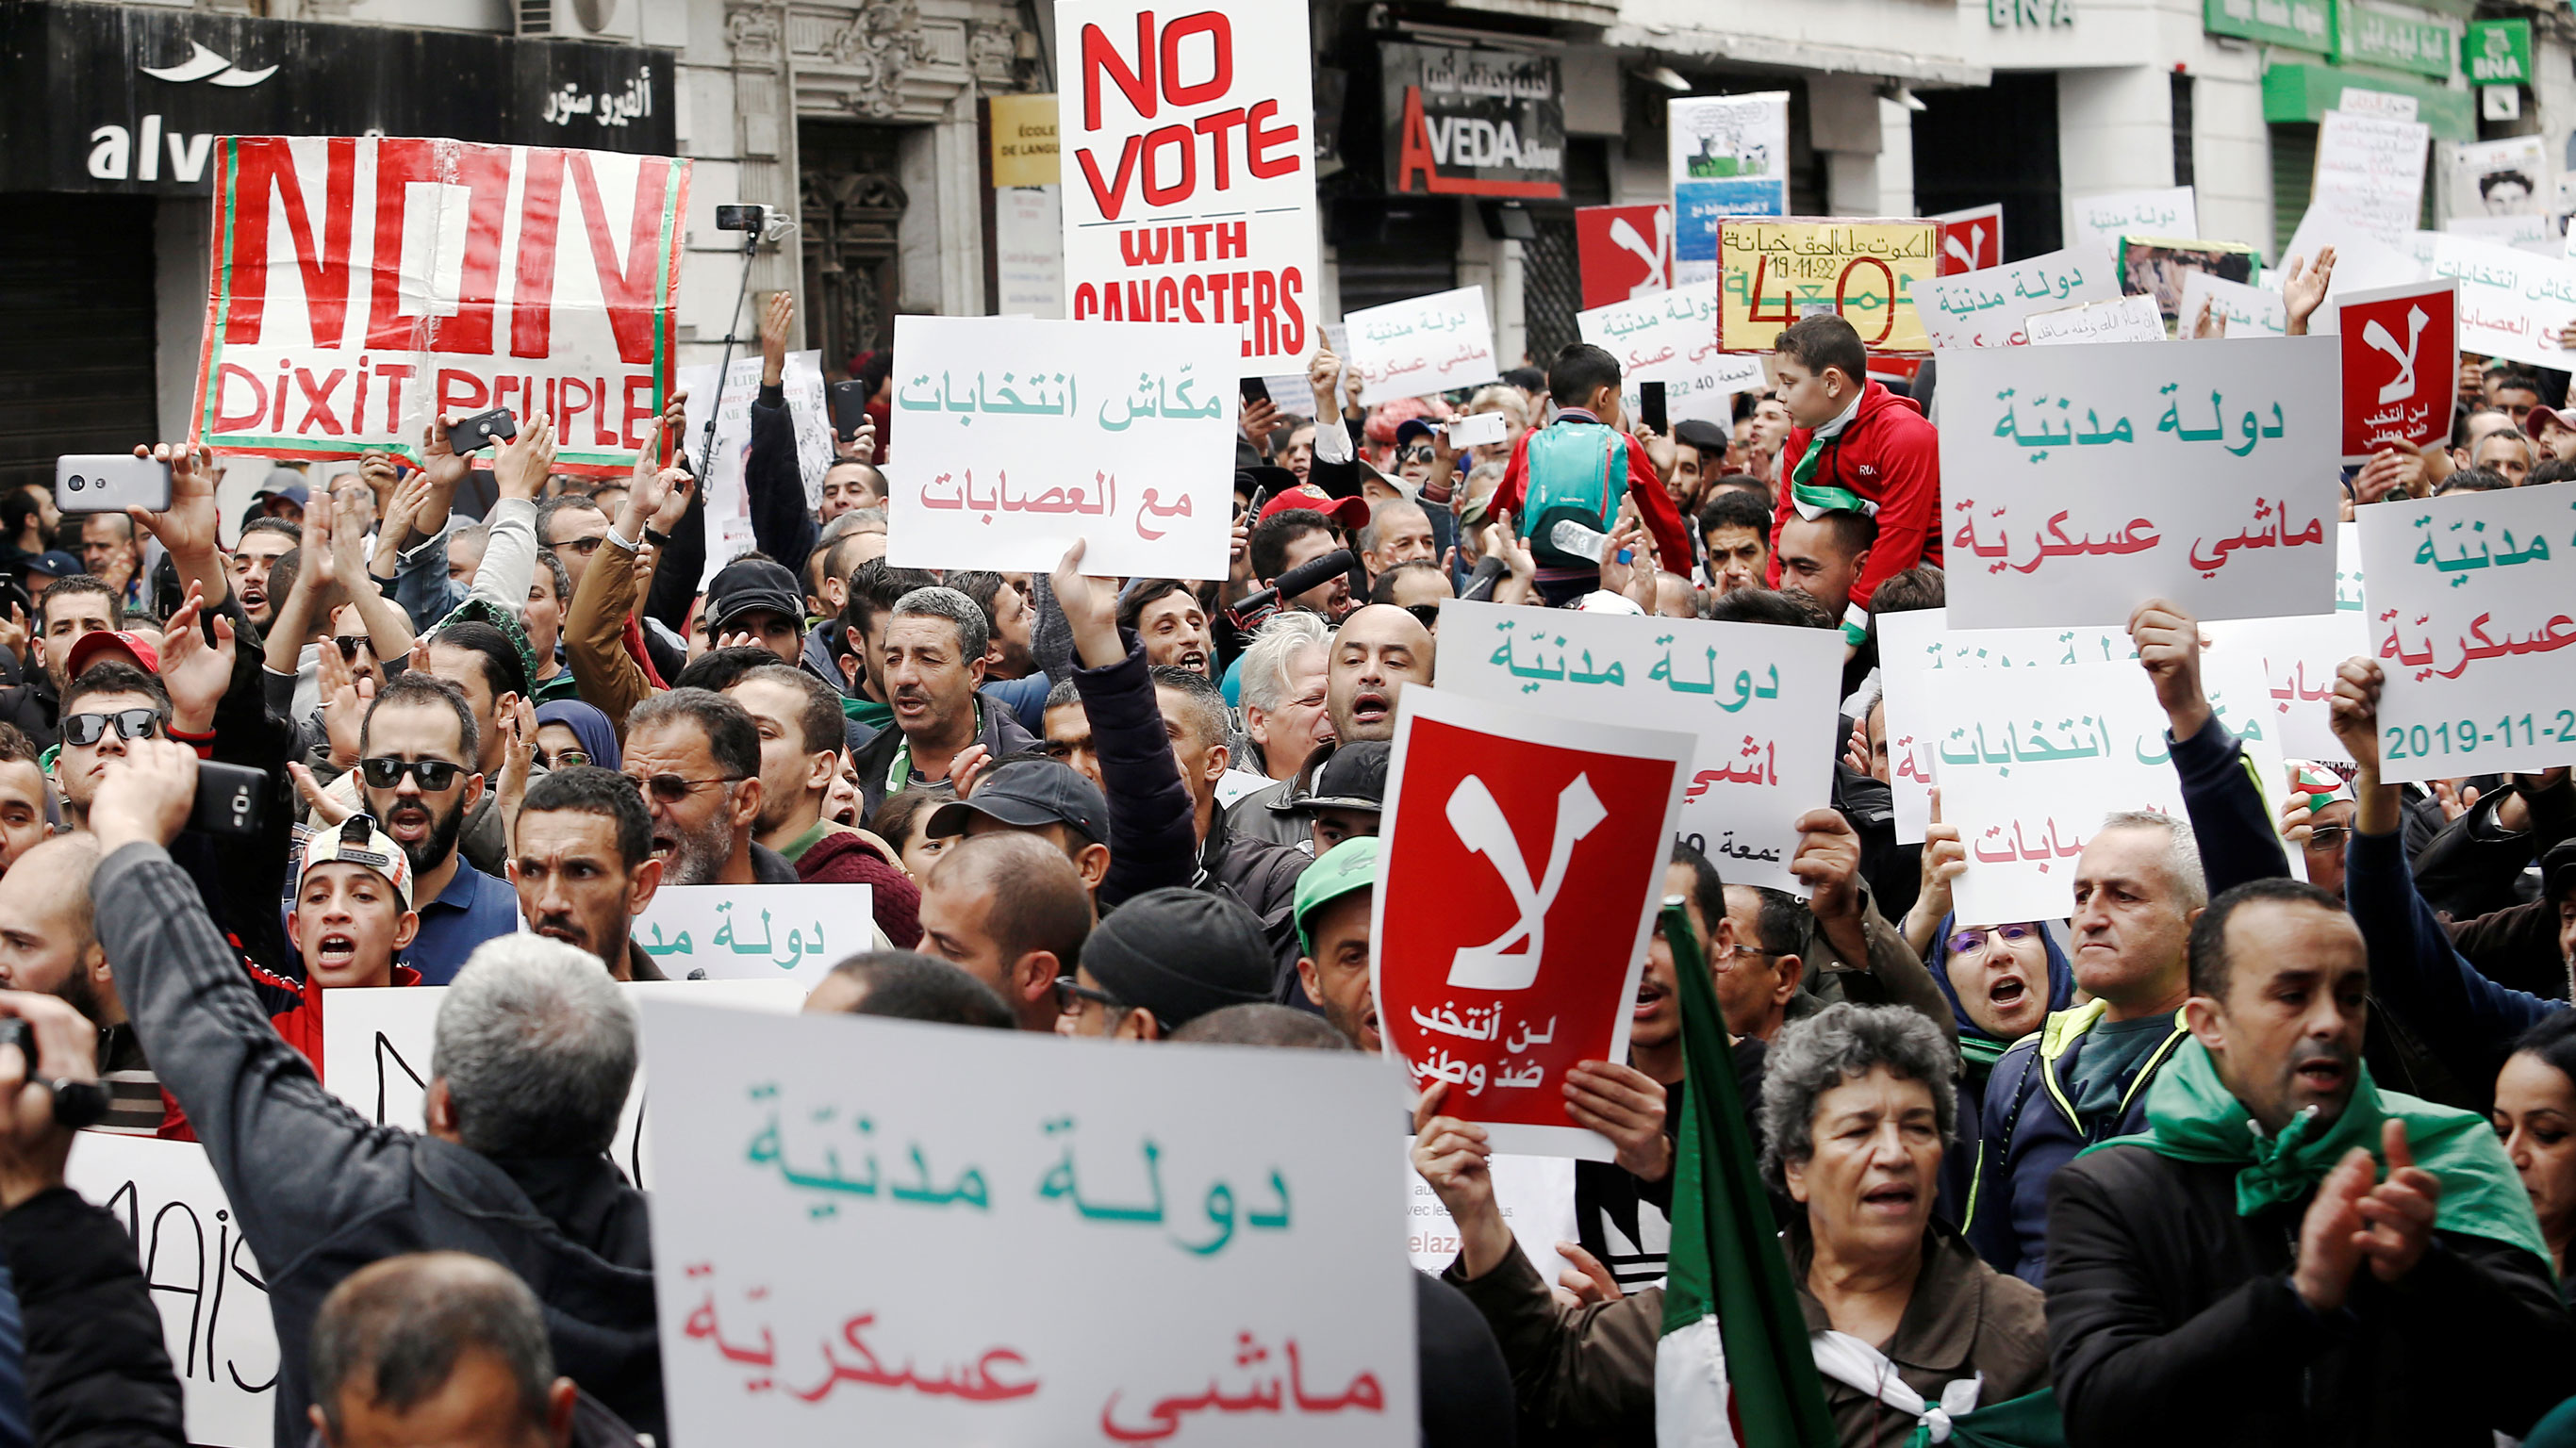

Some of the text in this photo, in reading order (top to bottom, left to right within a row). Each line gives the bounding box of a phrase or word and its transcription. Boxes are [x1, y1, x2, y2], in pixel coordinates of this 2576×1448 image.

[1082, 10, 1233, 131] NO
[2472, 53, 2523, 81] BNA
[1001, 143, 1060, 156] DE LANGU
[1018, 123, 1056, 139] ÉCOLE
[1075, 99, 1300, 221] VOTE
[1723, 227, 1792, 256] خيانة
[2133, 203, 2178, 230] دولة
[224, 136, 671, 365] NON
[1120, 222, 1247, 267] WITH
[1792, 229, 1839, 257] الحق
[1867, 228, 1936, 262] السكوت
[1937, 269, 2083, 321] دولة مدنيّة
[2435, 259, 2518, 290] انتخابات
[1075, 267, 1305, 357] GANGSTERS
[1418, 309, 1468, 334] دولة
[1603, 312, 1659, 342] مدنيّة
[2459, 304, 2531, 337] العصابا
[1437, 343, 1489, 374] ماشي
[1717, 362, 1759, 384] الجمعة
[2362, 303, 2431, 405] لا
[900, 373, 1075, 425] انتخابات
[1100, 368, 1220, 430] مكّاش
[1694, 374, 1716, 390] 40
[438, 369, 656, 451] PEUPLE
[1994, 383, 2284, 463] دولة مدنيّة
[2406, 402, 2430, 423] لن
[922, 471, 1191, 539] مع العصابات
[1954, 498, 2323, 579] ماشي عسكريّة
[2414, 516, 2550, 587] مدنيّة
[1490, 621, 1778, 713] دولة مدنيّة
[1942, 717, 2109, 777] انتخابات
[1445, 770, 1609, 992] لا
[714, 902, 822, 969] دولة
[1410, 999, 1559, 1049] لن أنتخب
[747, 1086, 1290, 1258] دولة مدنيّة
[685, 1265, 1385, 1448] ماشي عسكريّة
